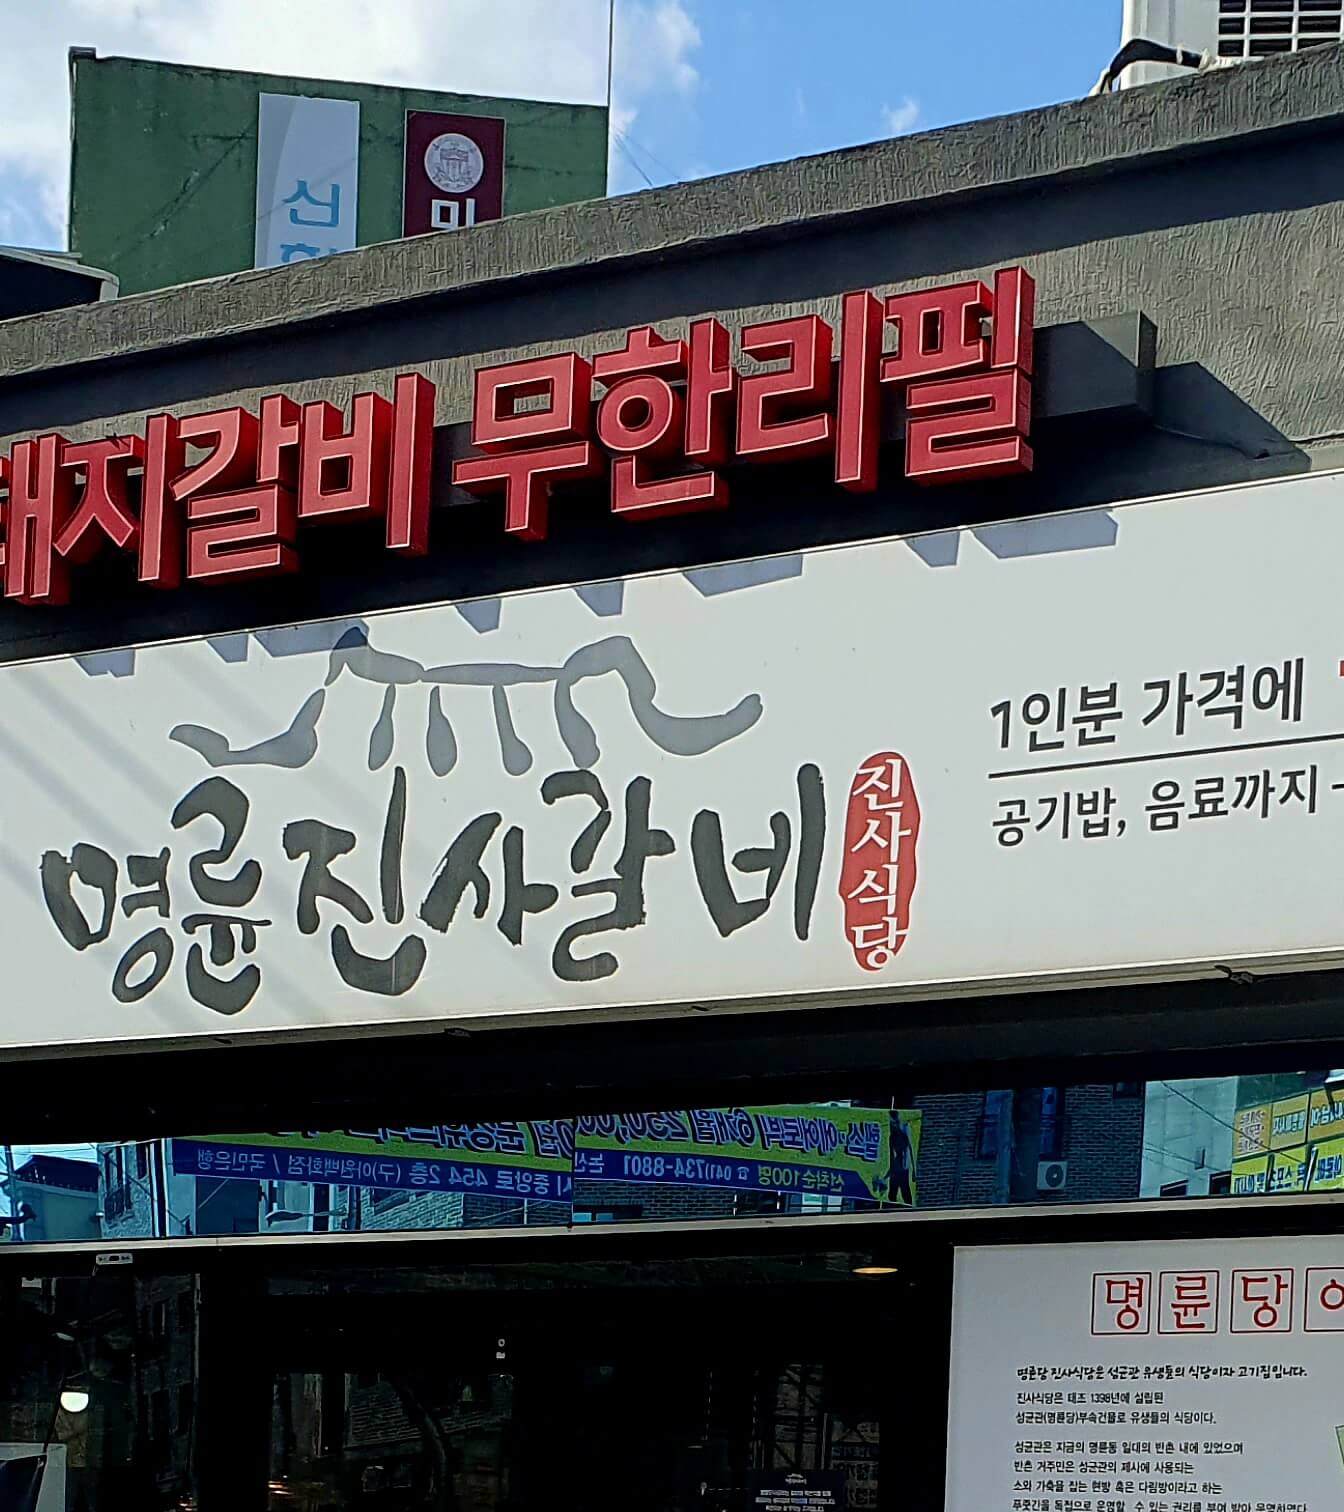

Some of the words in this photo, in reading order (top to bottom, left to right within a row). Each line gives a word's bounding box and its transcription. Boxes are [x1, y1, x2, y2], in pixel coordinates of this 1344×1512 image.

[453, 266, 1036, 539] 무한리필
[989, 682, 1123, 751] 1인분
[1141, 658, 1305, 729] 가격에
[992, 785, 1127, 847] 공기밥,
[1145, 766, 1320, 831] 음료까지
[40, 764, 824, 1014] 명륜진사갈비
[850, 758, 912, 967] 진사식당
